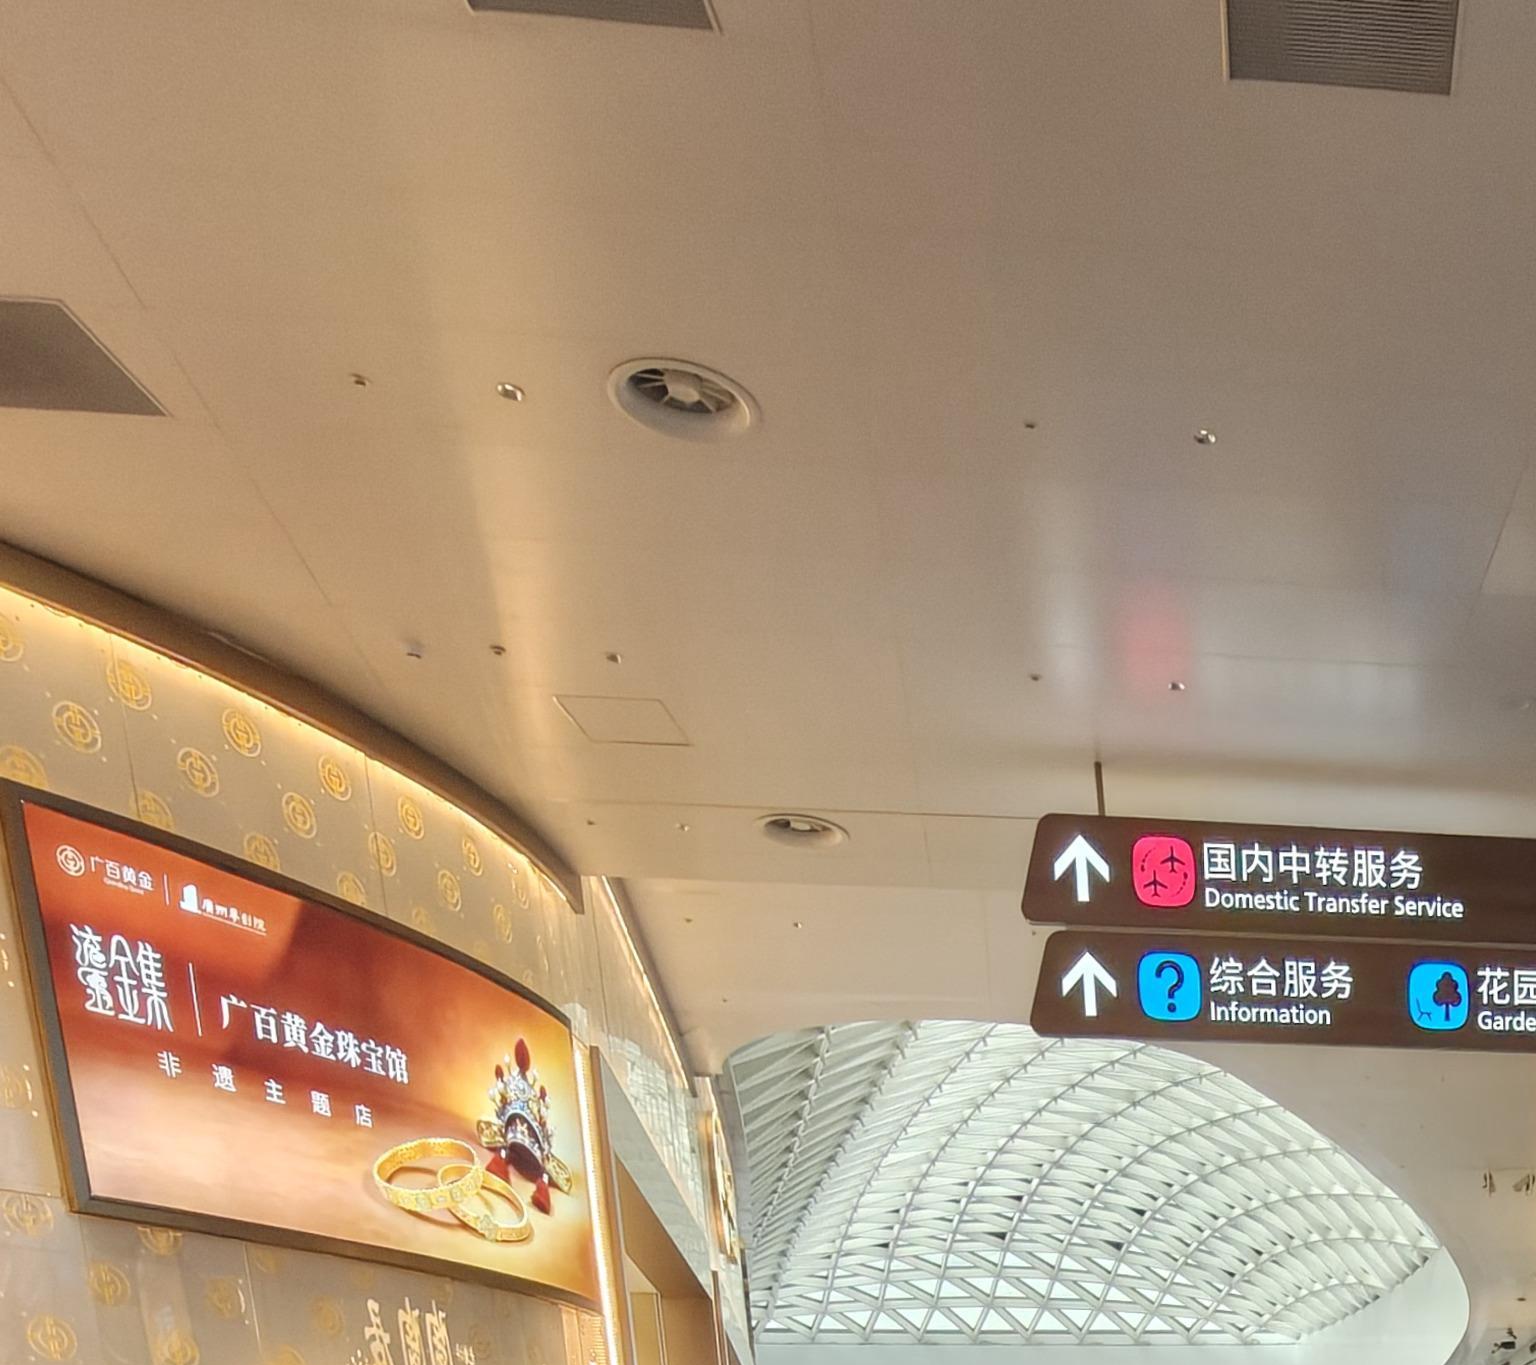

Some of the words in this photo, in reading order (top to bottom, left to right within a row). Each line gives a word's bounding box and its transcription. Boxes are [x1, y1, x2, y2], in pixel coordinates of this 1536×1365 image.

[90, 856, 153, 891] 广百黄金
[1203, 842, 1424, 890] 国内中转服务
[1204, 887, 1300, 913] Domestic
[1303, 891, 1390, 916] Transfer
[1393, 895, 1464, 918] Service
[1209, 956, 1355, 1001] 综合服务
[1210, 1000, 1331, 1026] Information
[219, 994, 409, 1085] 广百黄金珠宝馆
[158, 1050, 374, 1129] 非遗主题店
